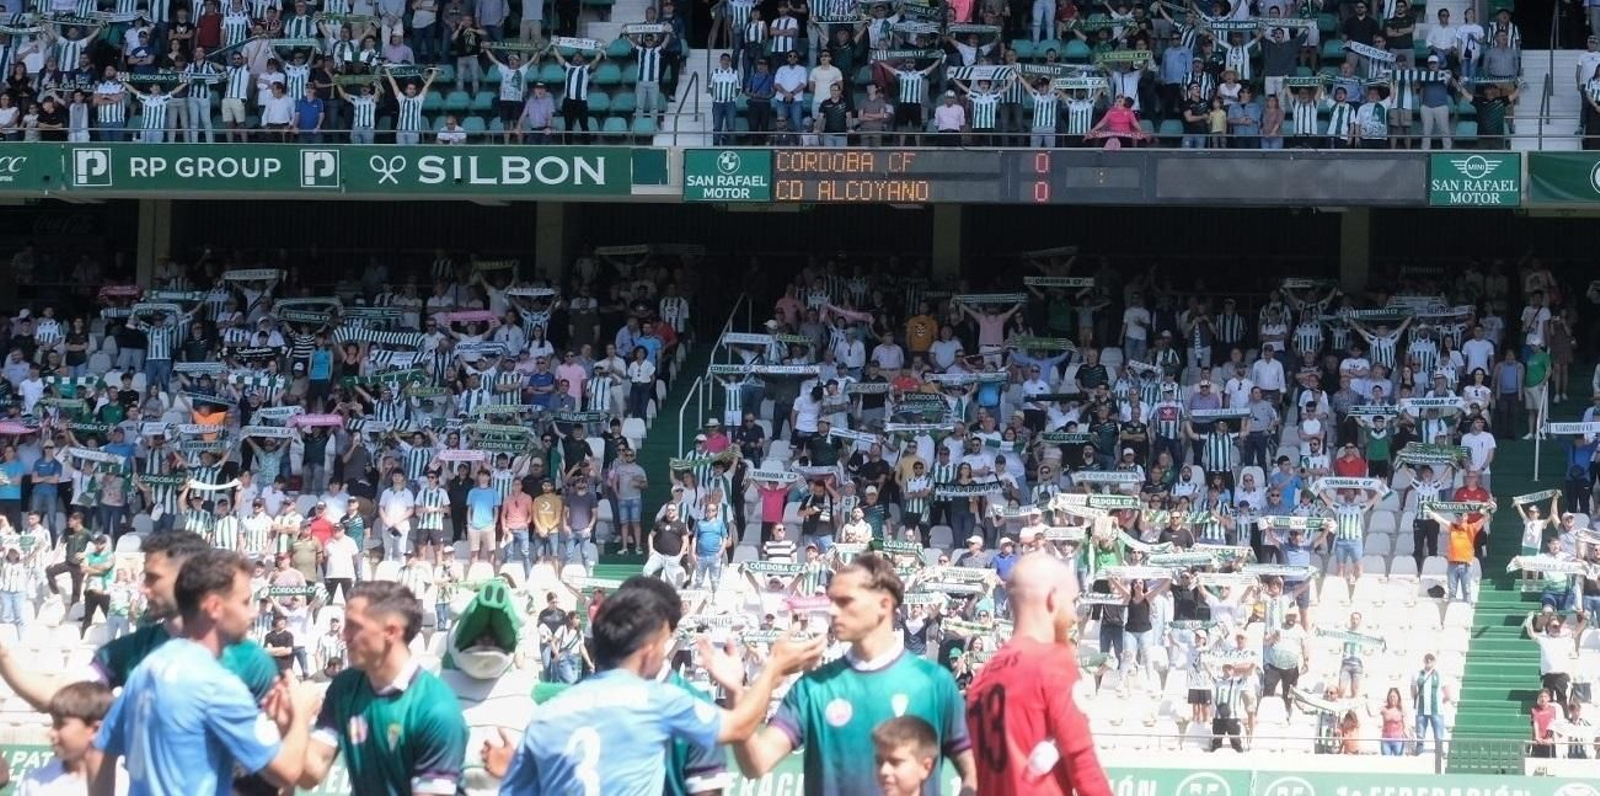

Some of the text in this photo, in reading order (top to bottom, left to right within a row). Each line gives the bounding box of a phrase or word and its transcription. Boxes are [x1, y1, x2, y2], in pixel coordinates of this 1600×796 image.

[130, 157, 281, 178] RP GROUP
[418, 155, 605, 185] SILBON
[777, 152, 916, 172] CORDOBA CF
[1035, 153, 1050, 173] 0
[686, 175, 768, 187] SAN RAFAEL
[775, 180, 929, 201] CD ALCOYANO
[1432, 180, 1518, 192] SAN RAFAEL
[703, 187, 750, 200] MOTOR
[1034, 181, 1049, 202] 0
[1449, 192, 1501, 204] MOTOR
